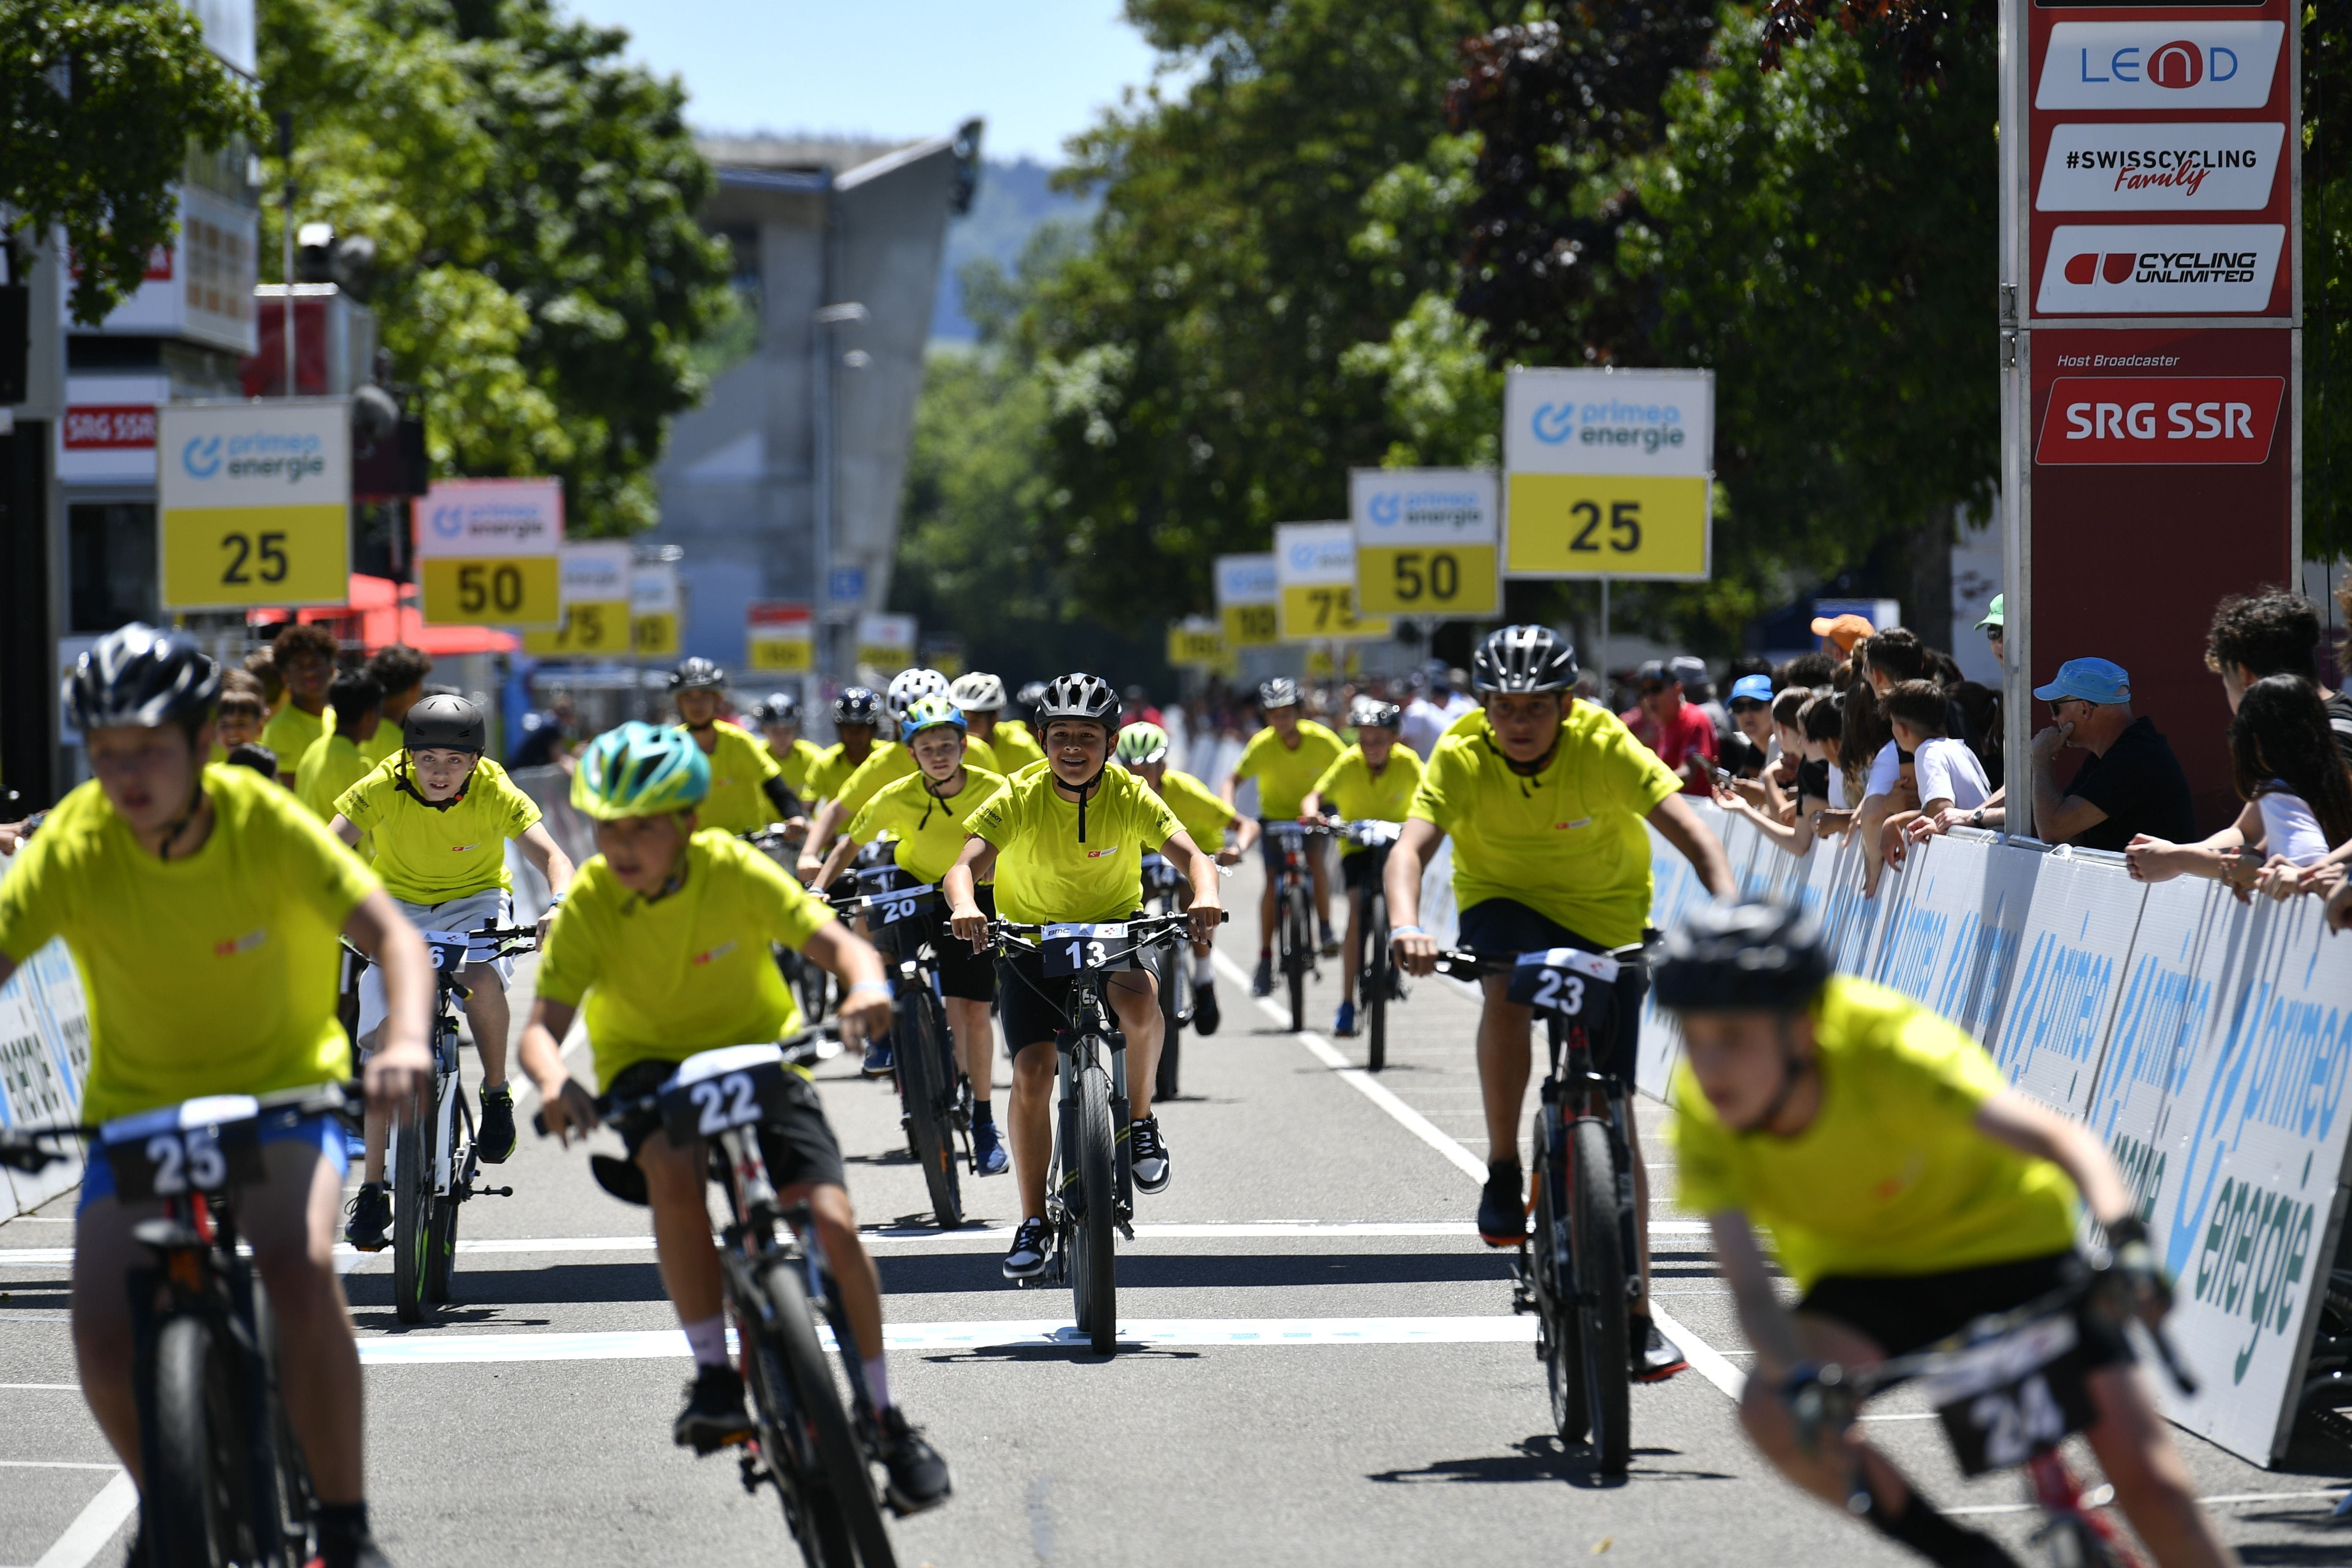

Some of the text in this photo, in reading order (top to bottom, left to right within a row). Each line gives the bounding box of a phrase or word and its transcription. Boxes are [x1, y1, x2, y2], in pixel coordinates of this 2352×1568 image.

[2066, 149, 2257, 169] #SWISSCYCLING
[2114, 160, 2210, 196] Family
[2135, 270, 2255, 283] UNLIMITED
[2138, 252, 2257, 269] CYCLING
[2057, 354, 2180, 367] Host Broadcaster
[68, 413, 155, 442] SRG SSR
[1581, 399, 1680, 425] primeo
[2066, 402, 2254, 439] SRG SSR
[228, 432, 321, 453] primeo
[1580, 425, 1685, 455] energie
[228, 453, 324, 483] energie
[1404, 507, 1484, 530] energie
[1568, 499, 1642, 553] 25
[220, 531, 289, 585] 25
[457, 564, 523, 614] 50
[1393, 552, 1459, 601] 50
[985, 807, 1003, 823] TISSOT
[882, 898, 916, 924] 20
[1048, 928, 1070, 936] BMC
[1065, 941, 1107, 969] 13
[1532, 969, 1585, 1015] 23
[2025, 909, 2112, 1073] primeo
[2123, 928, 2211, 1111] primeo
[2234, 951, 2352, 1152] primeo
[691, 1070, 762, 1136] 22
[146, 1131, 228, 1197] 25
[2195, 1149, 2314, 1387] energie
[1970, 1375, 2066, 1467] 24
